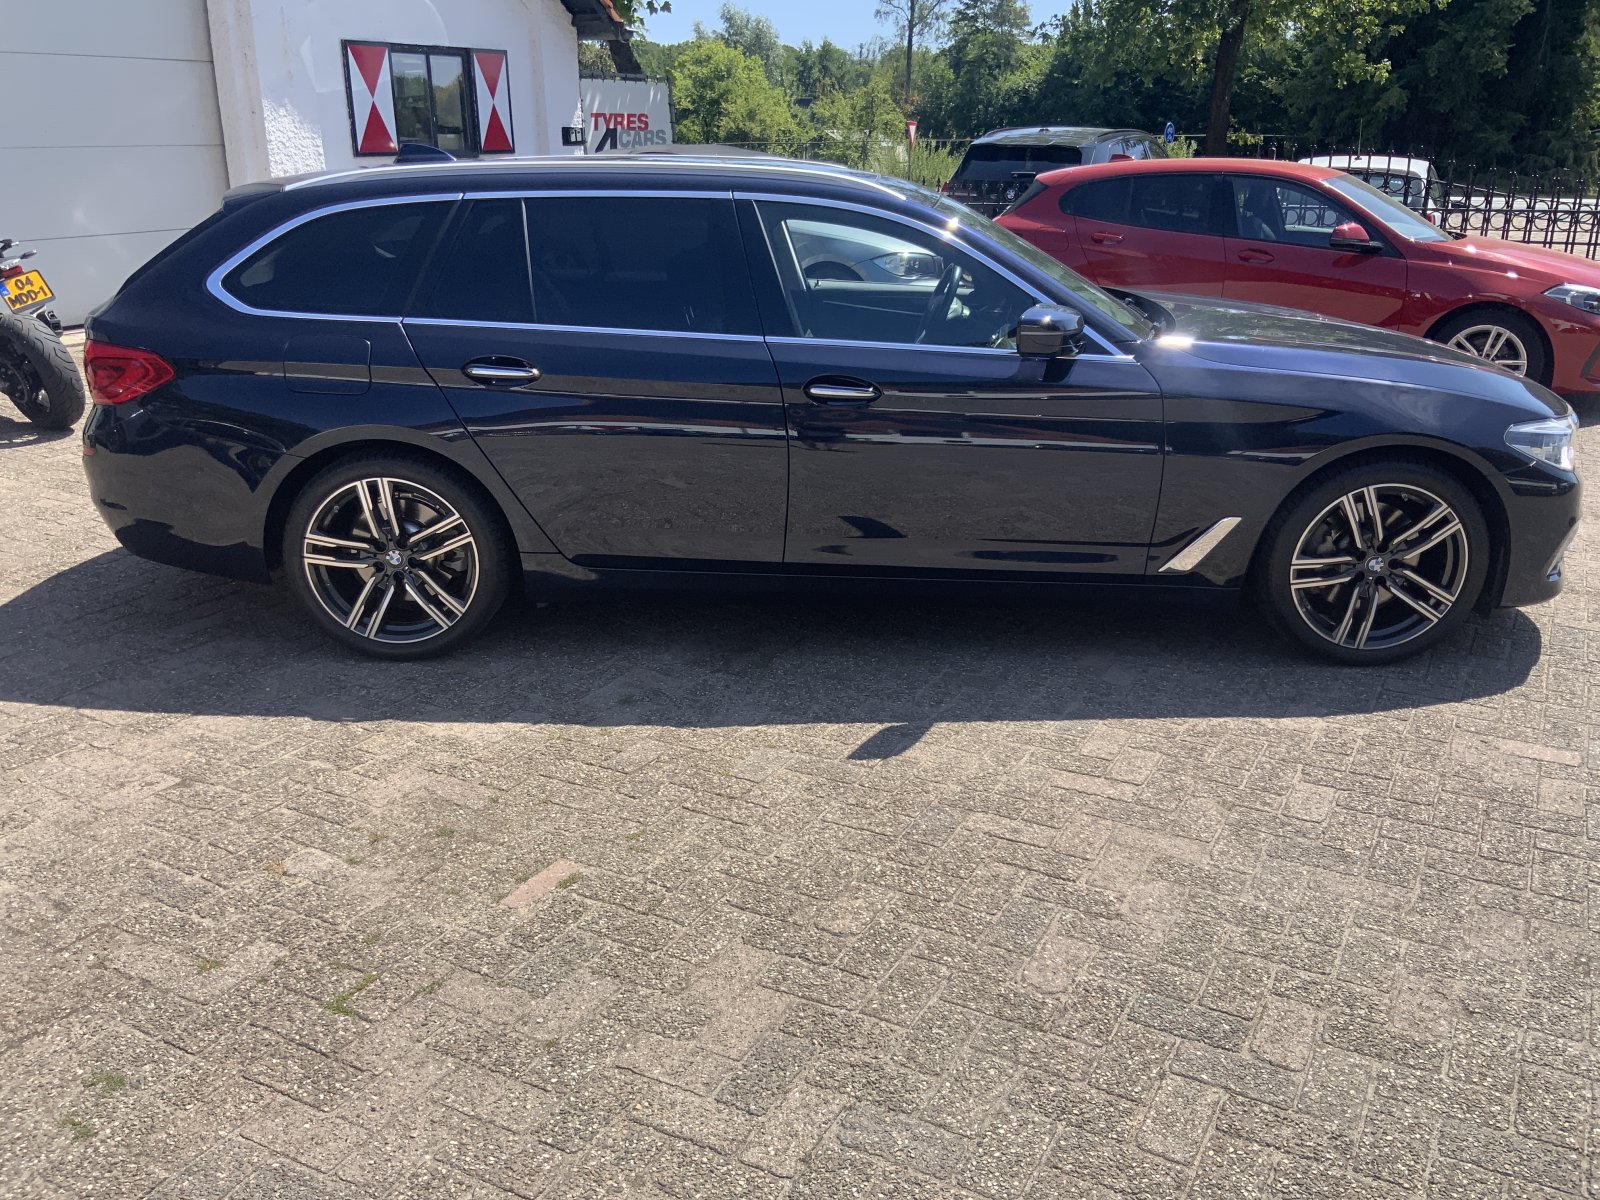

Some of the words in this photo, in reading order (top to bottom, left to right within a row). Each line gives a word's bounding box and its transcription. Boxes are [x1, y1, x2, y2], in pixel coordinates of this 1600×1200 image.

[591, 112, 649, 132] TYRES
[618, 129, 667, 148] CARS
[14, 275, 34, 291] 04
[7, 286, 48, 308] MDD-1
